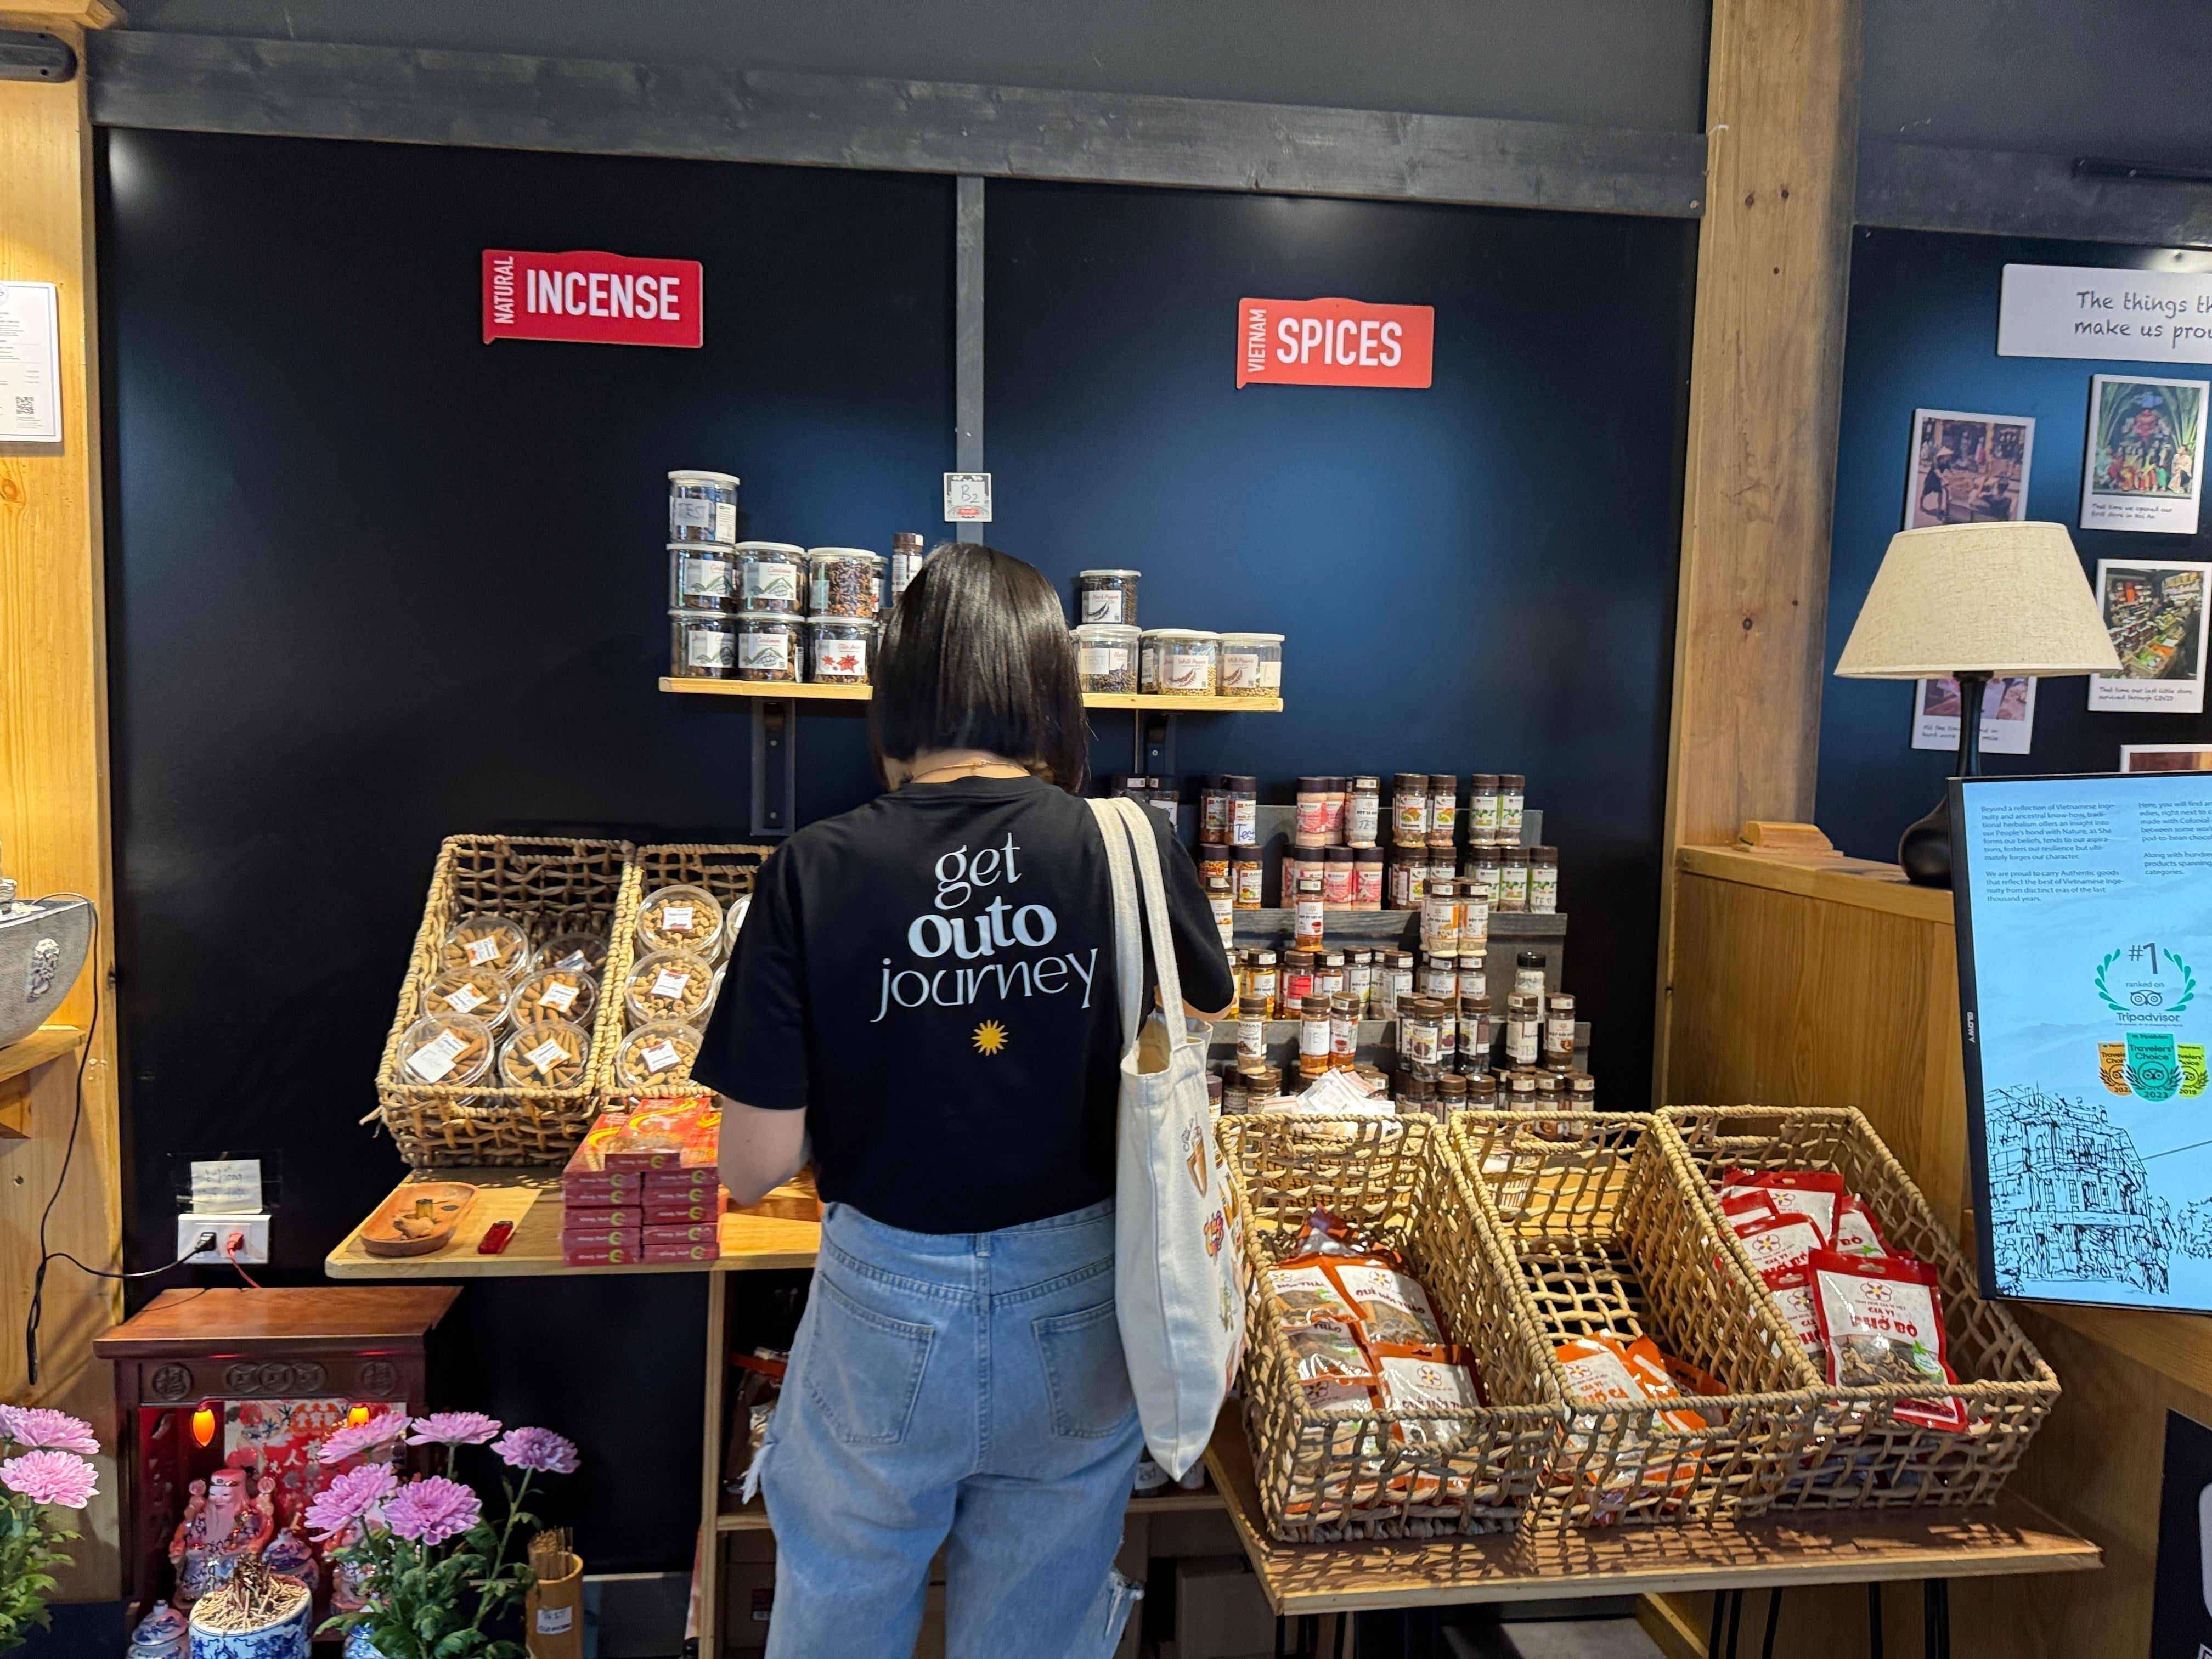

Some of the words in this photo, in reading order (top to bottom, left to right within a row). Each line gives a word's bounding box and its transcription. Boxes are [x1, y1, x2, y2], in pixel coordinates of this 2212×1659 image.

[494, 256, 514, 324] NATURAL
[527, 269, 680, 320] INCENSE
[2076, 291, 2114, 310] The
[2123, 292, 2188, 319] things
[1248, 309, 1267, 373] VIETNAM
[1277, 317, 1402, 367] SPICES
[2074, 319, 2130, 336] make
[2141, 323, 2163, 337] us
[2069, 820, 2094, 828] insight
[934, 832, 1022, 910] get
[2096, 869, 2120, 877] goods
[907, 896, 1057, 960] outo
[2128, 942, 2158, 975] #1
[869, 948, 1098, 1023] journey
[2116, 1012, 2180, 1023] Tripadvisor
[1356, 1286, 1376, 1296] QUẾ
[1867, 1306, 1883, 1314] GIA
[1893, 1320, 1918, 1338] BÒ
